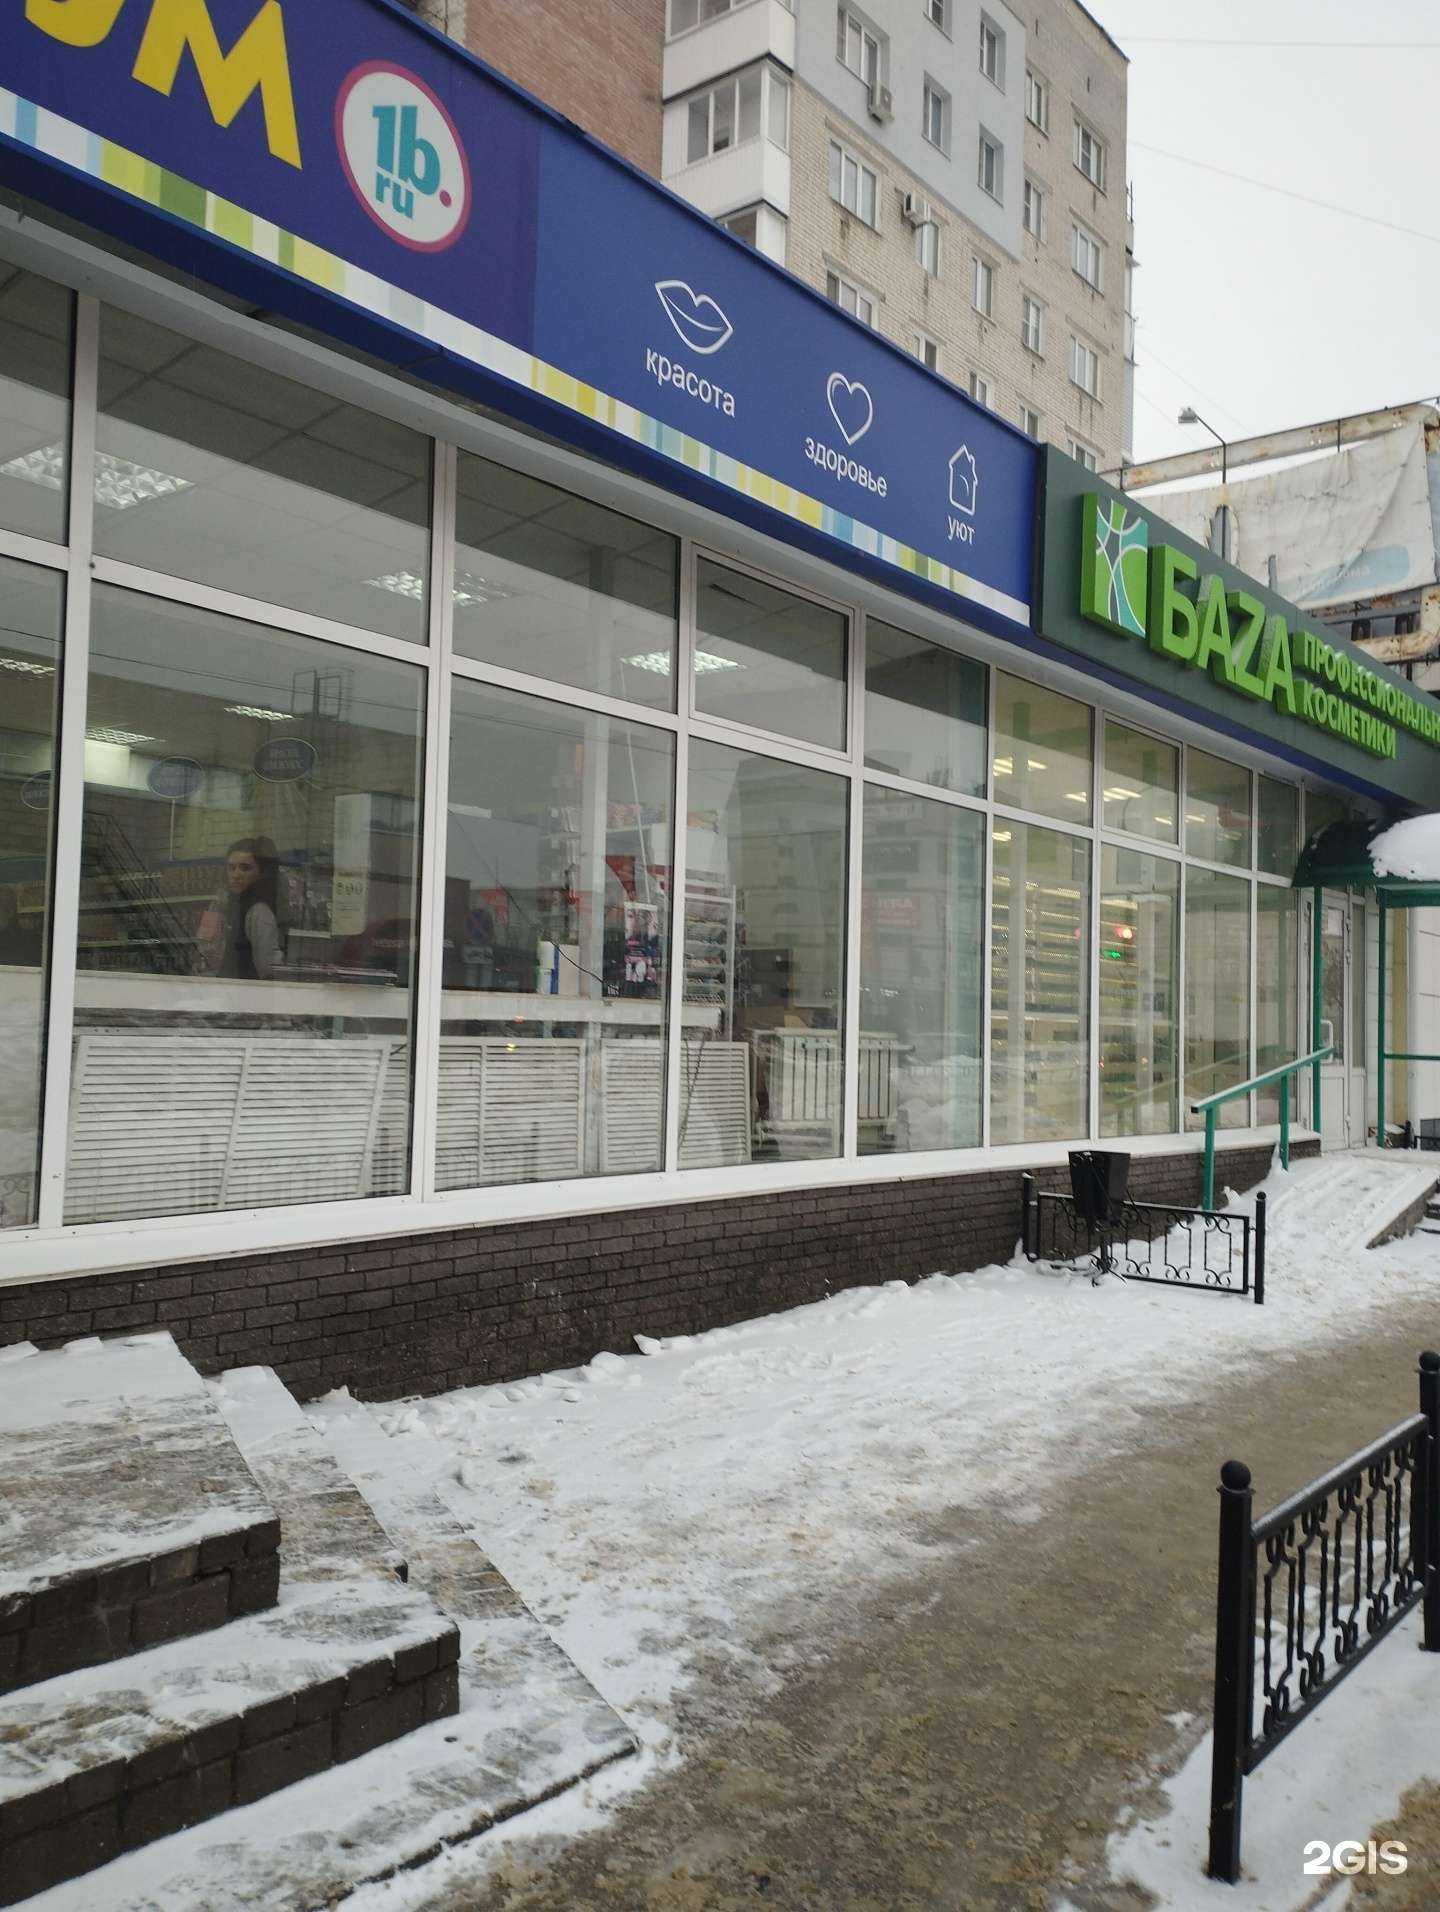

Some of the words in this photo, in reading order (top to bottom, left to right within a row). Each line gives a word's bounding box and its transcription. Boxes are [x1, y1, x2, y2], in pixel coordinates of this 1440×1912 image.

[25, 0, 303, 170] М
[375, 172, 415, 219] ru
[645, 347, 736, 418] красота
[804, 436, 888, 498] здоровье
[946, 514, 976, 545] уют
[1301, 678, 1397, 760] КОСМЕТИКИ
